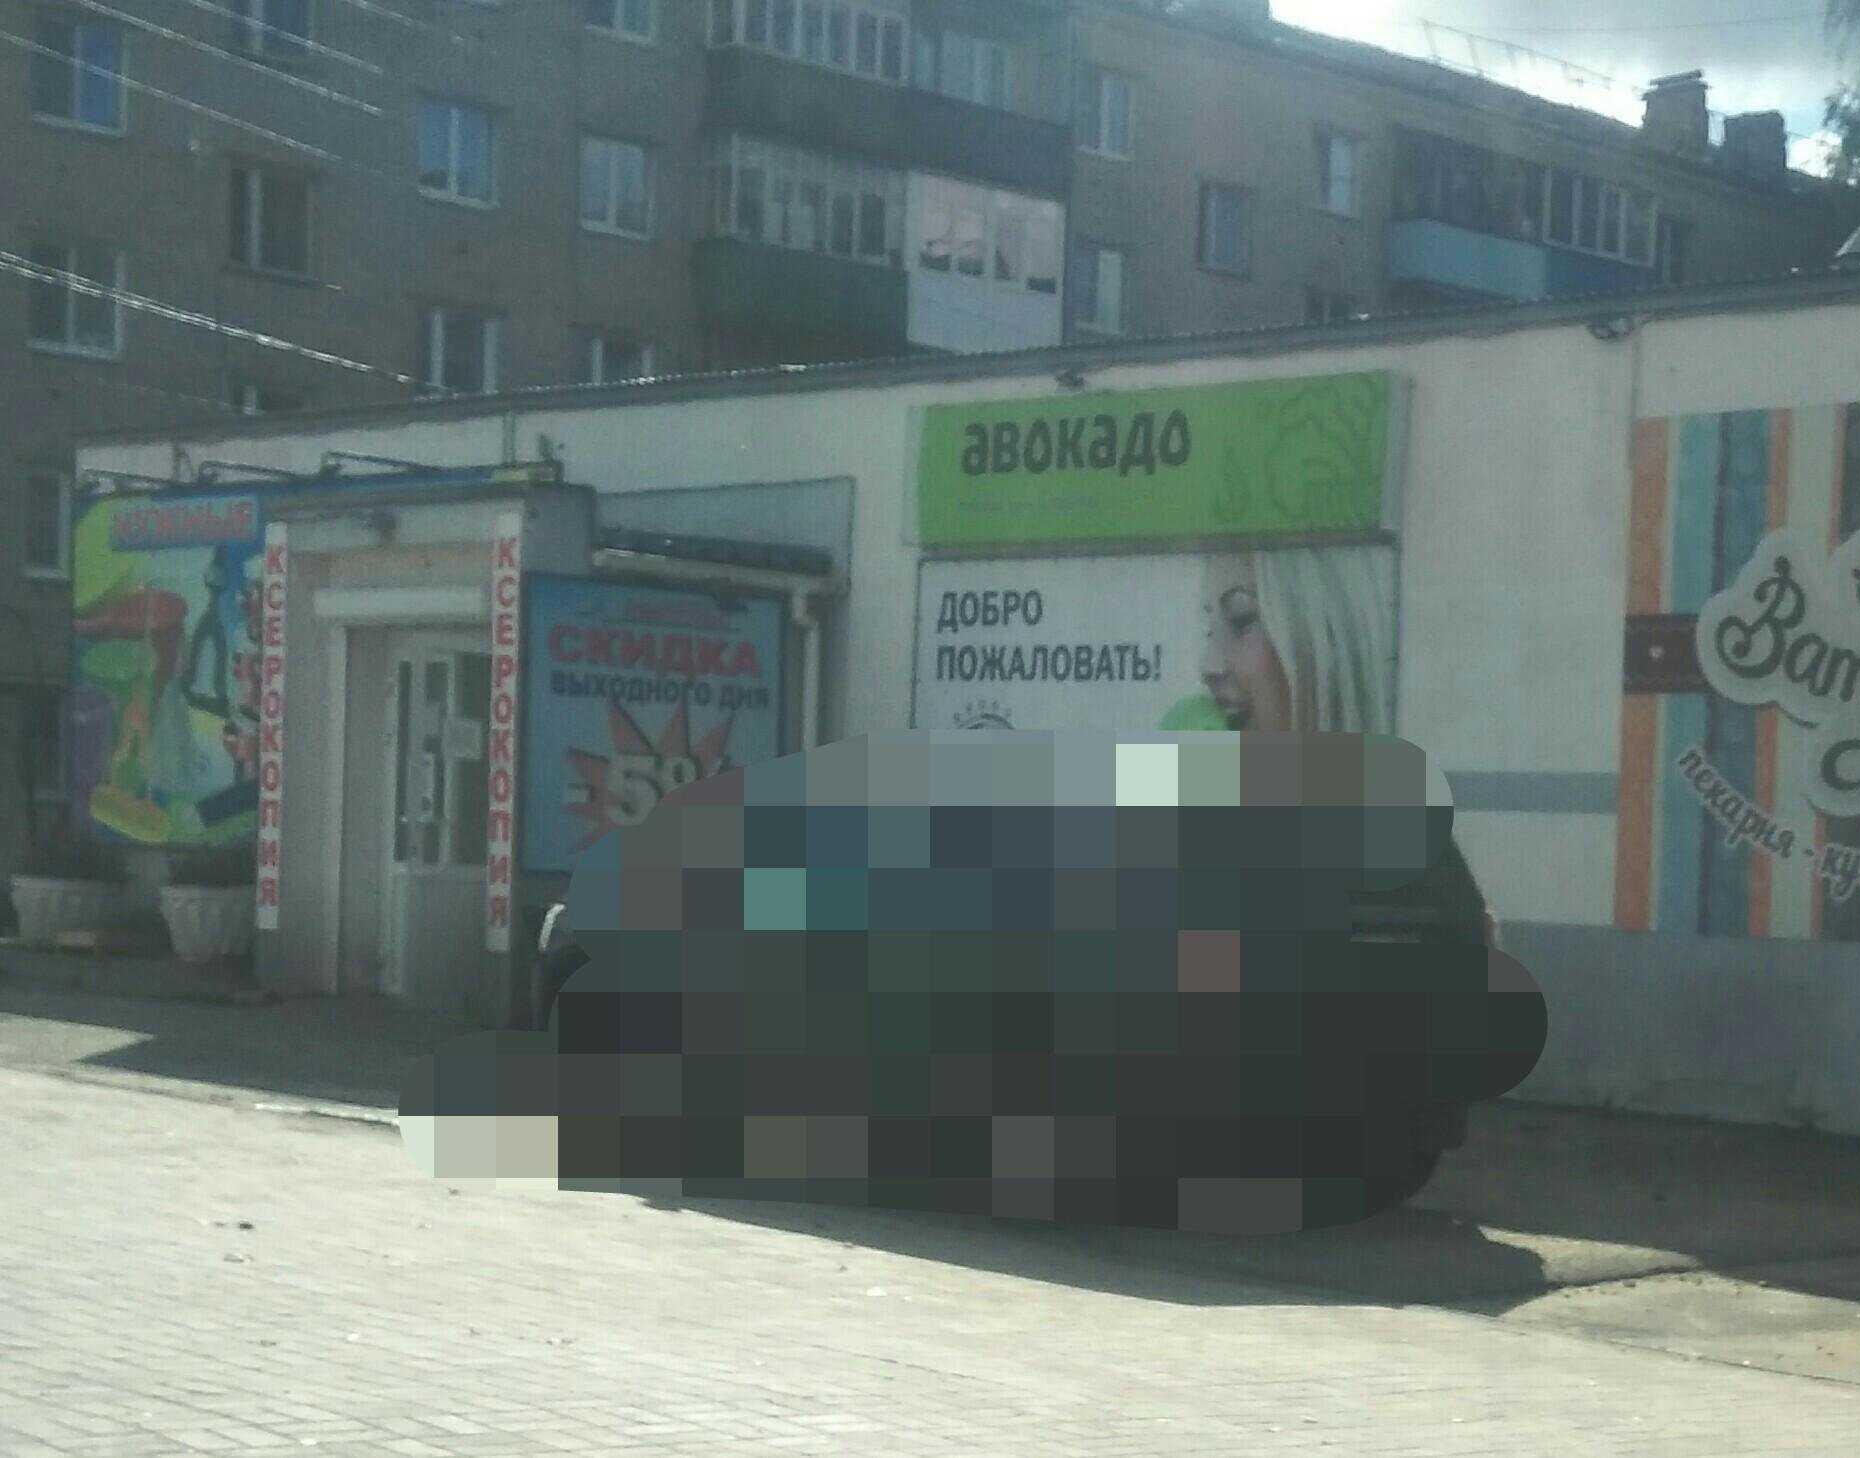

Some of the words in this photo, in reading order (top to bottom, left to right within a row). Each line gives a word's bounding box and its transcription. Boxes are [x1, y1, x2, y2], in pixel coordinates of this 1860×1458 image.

[936, 589, 1044, 634] ДОБРО
[547, 624, 762, 678] СКИДКА
[935, 642, 1162, 684] ПОЖАЛОВАТЬ!
[550, 670, 713, 708] ВЫХОДНОГО
[718, 684, 770, 711] ДНЯ
[257, 543, 287, 909] КСЕРОКОПИЯ
[486, 536, 520, 928] КСЕРОКОПИЯ
[1677, 748, 1796, 860] пекарня
